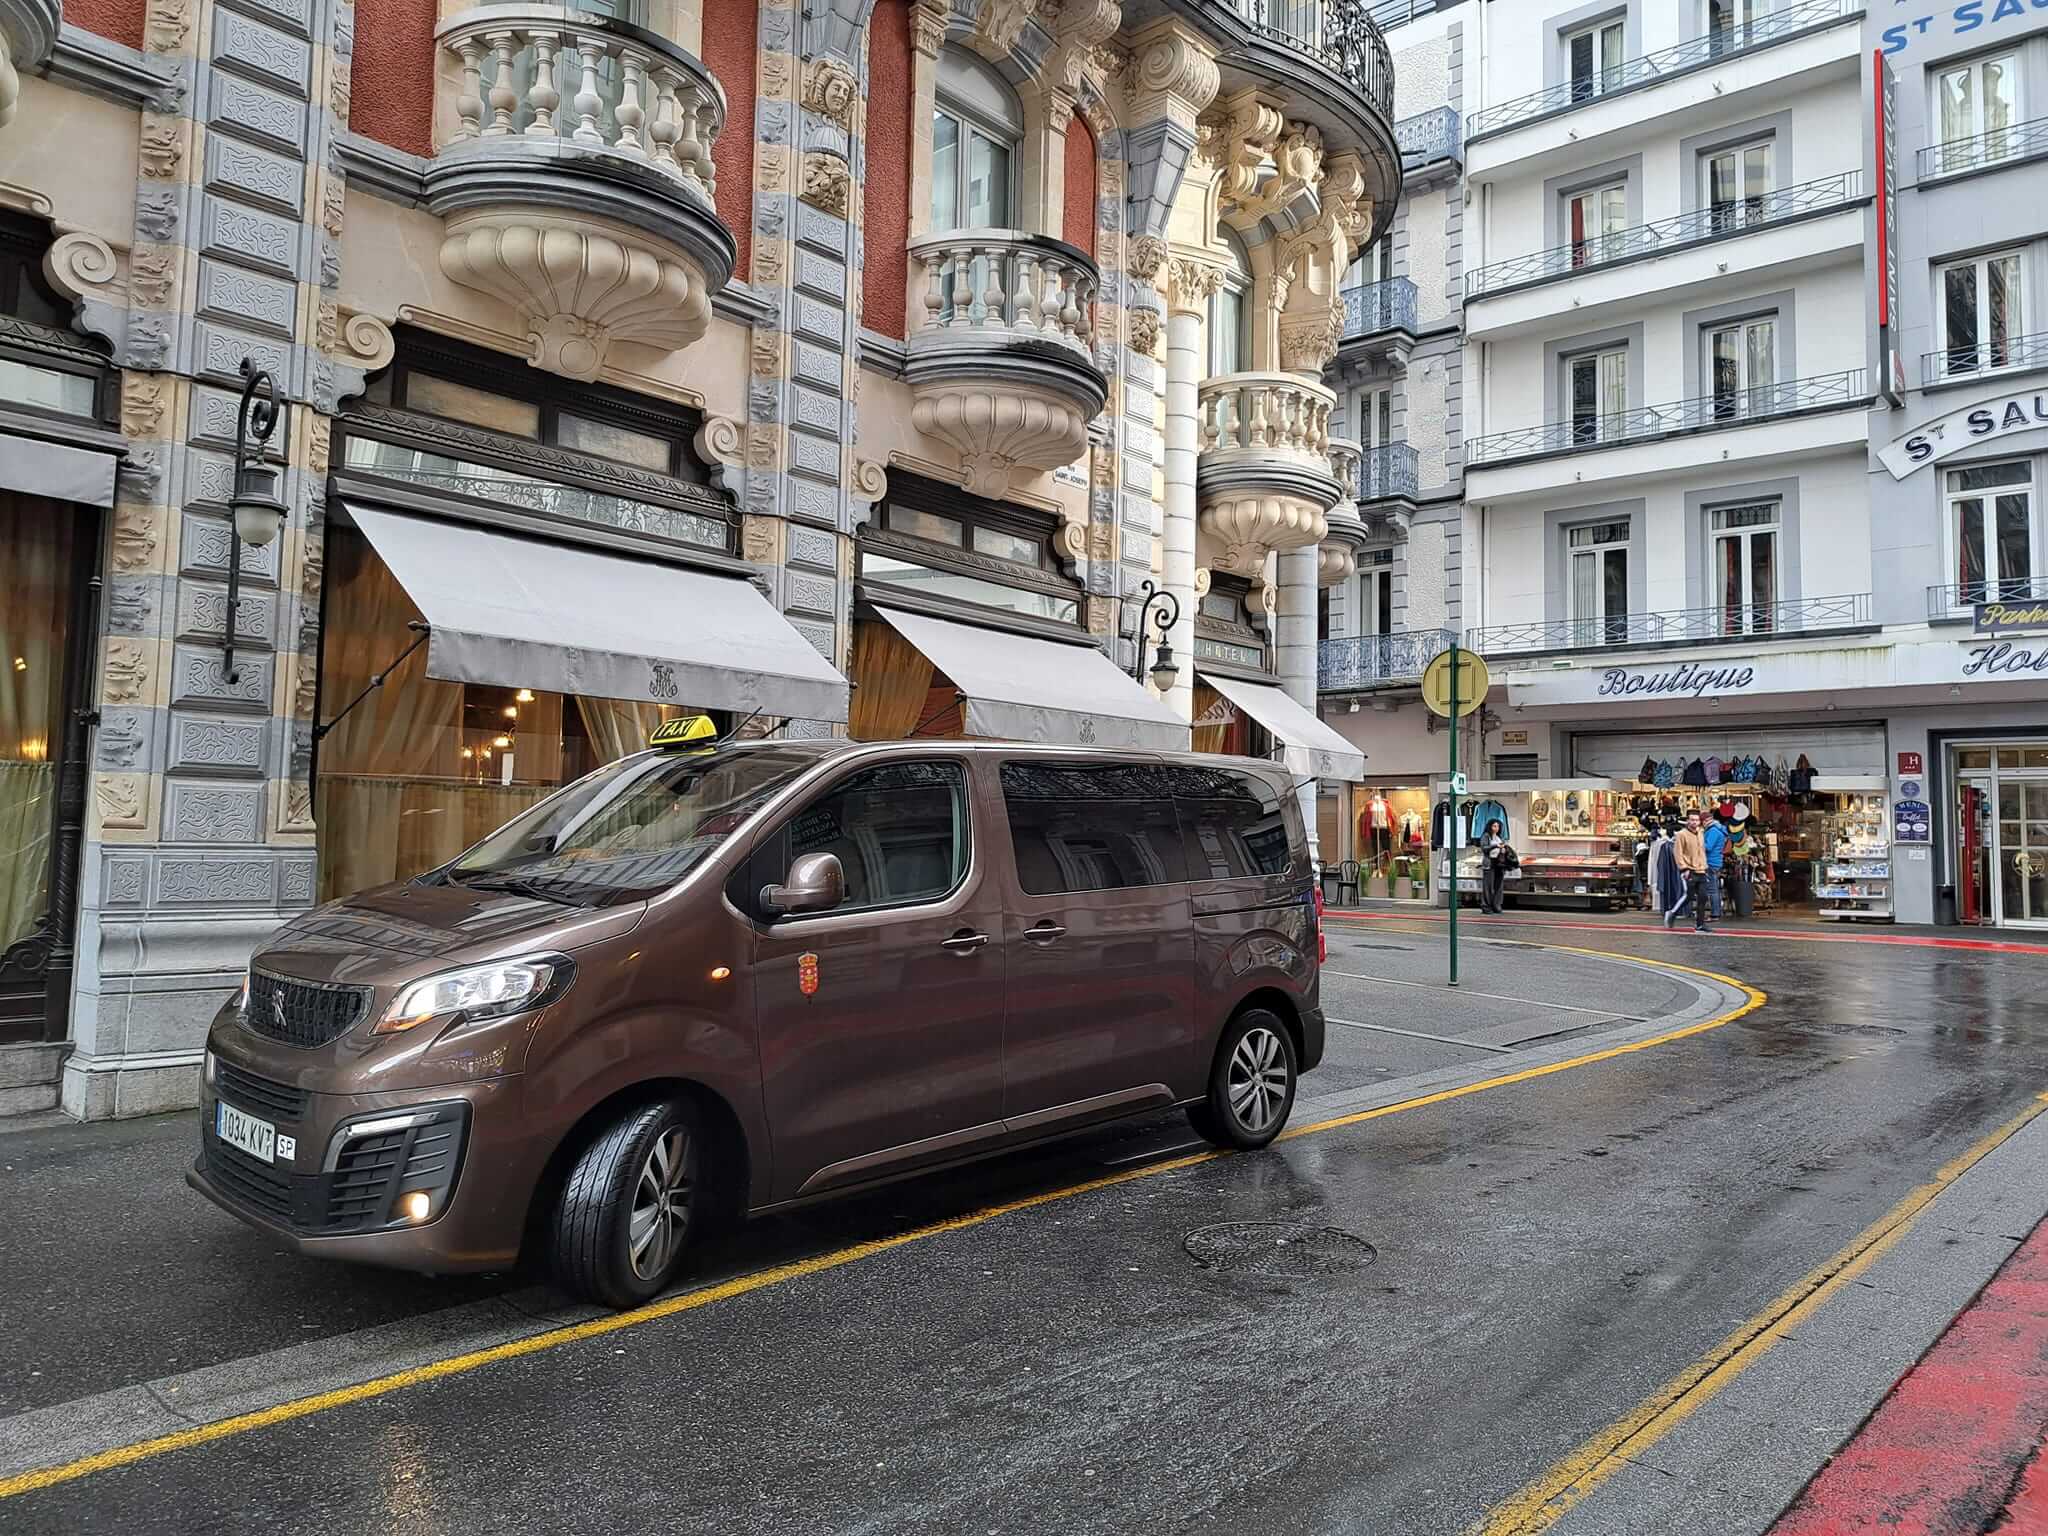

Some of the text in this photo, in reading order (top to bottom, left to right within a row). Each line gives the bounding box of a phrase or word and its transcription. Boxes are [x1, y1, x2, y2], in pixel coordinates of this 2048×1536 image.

[1887, 242, 1897, 332] SAINT
[1598, 663, 1754, 697] Boutique
[658, 719, 696, 737] TAXI
[1909, 756, 1918, 765] H
[224, 1110, 272, 1156] 1034 KVT
[279, 1138, 294, 1155] SP
